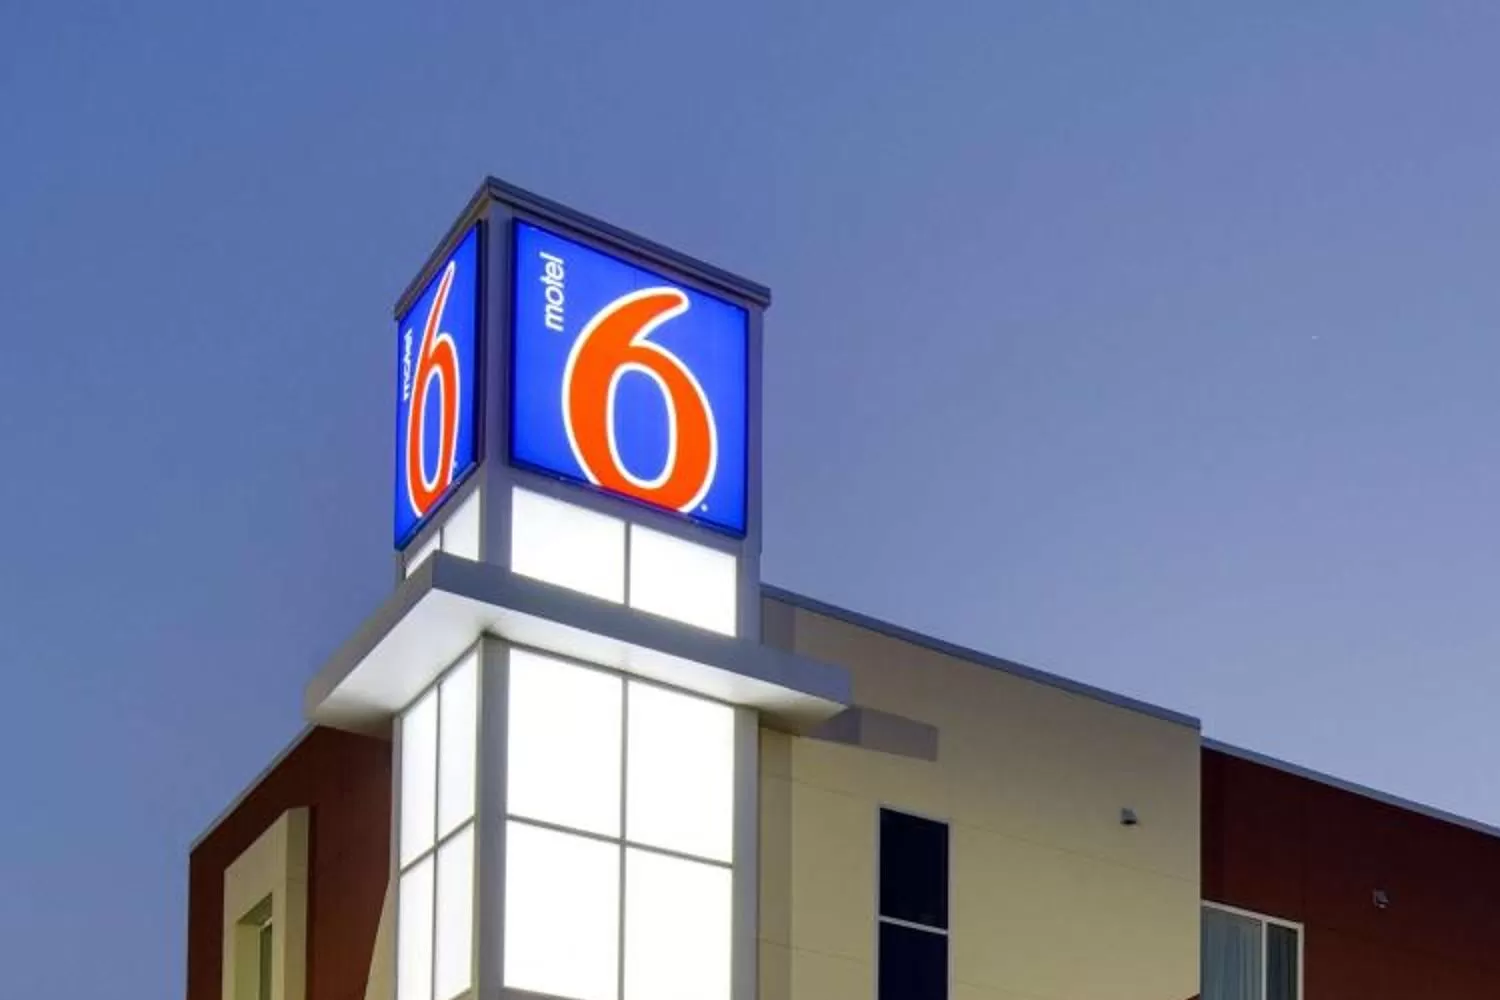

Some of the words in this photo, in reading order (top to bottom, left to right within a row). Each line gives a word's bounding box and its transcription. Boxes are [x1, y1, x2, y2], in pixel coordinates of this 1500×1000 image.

[407, 261, 460, 517] 6
[540, 253, 564, 331] motel
[562, 287, 717, 512] 6
